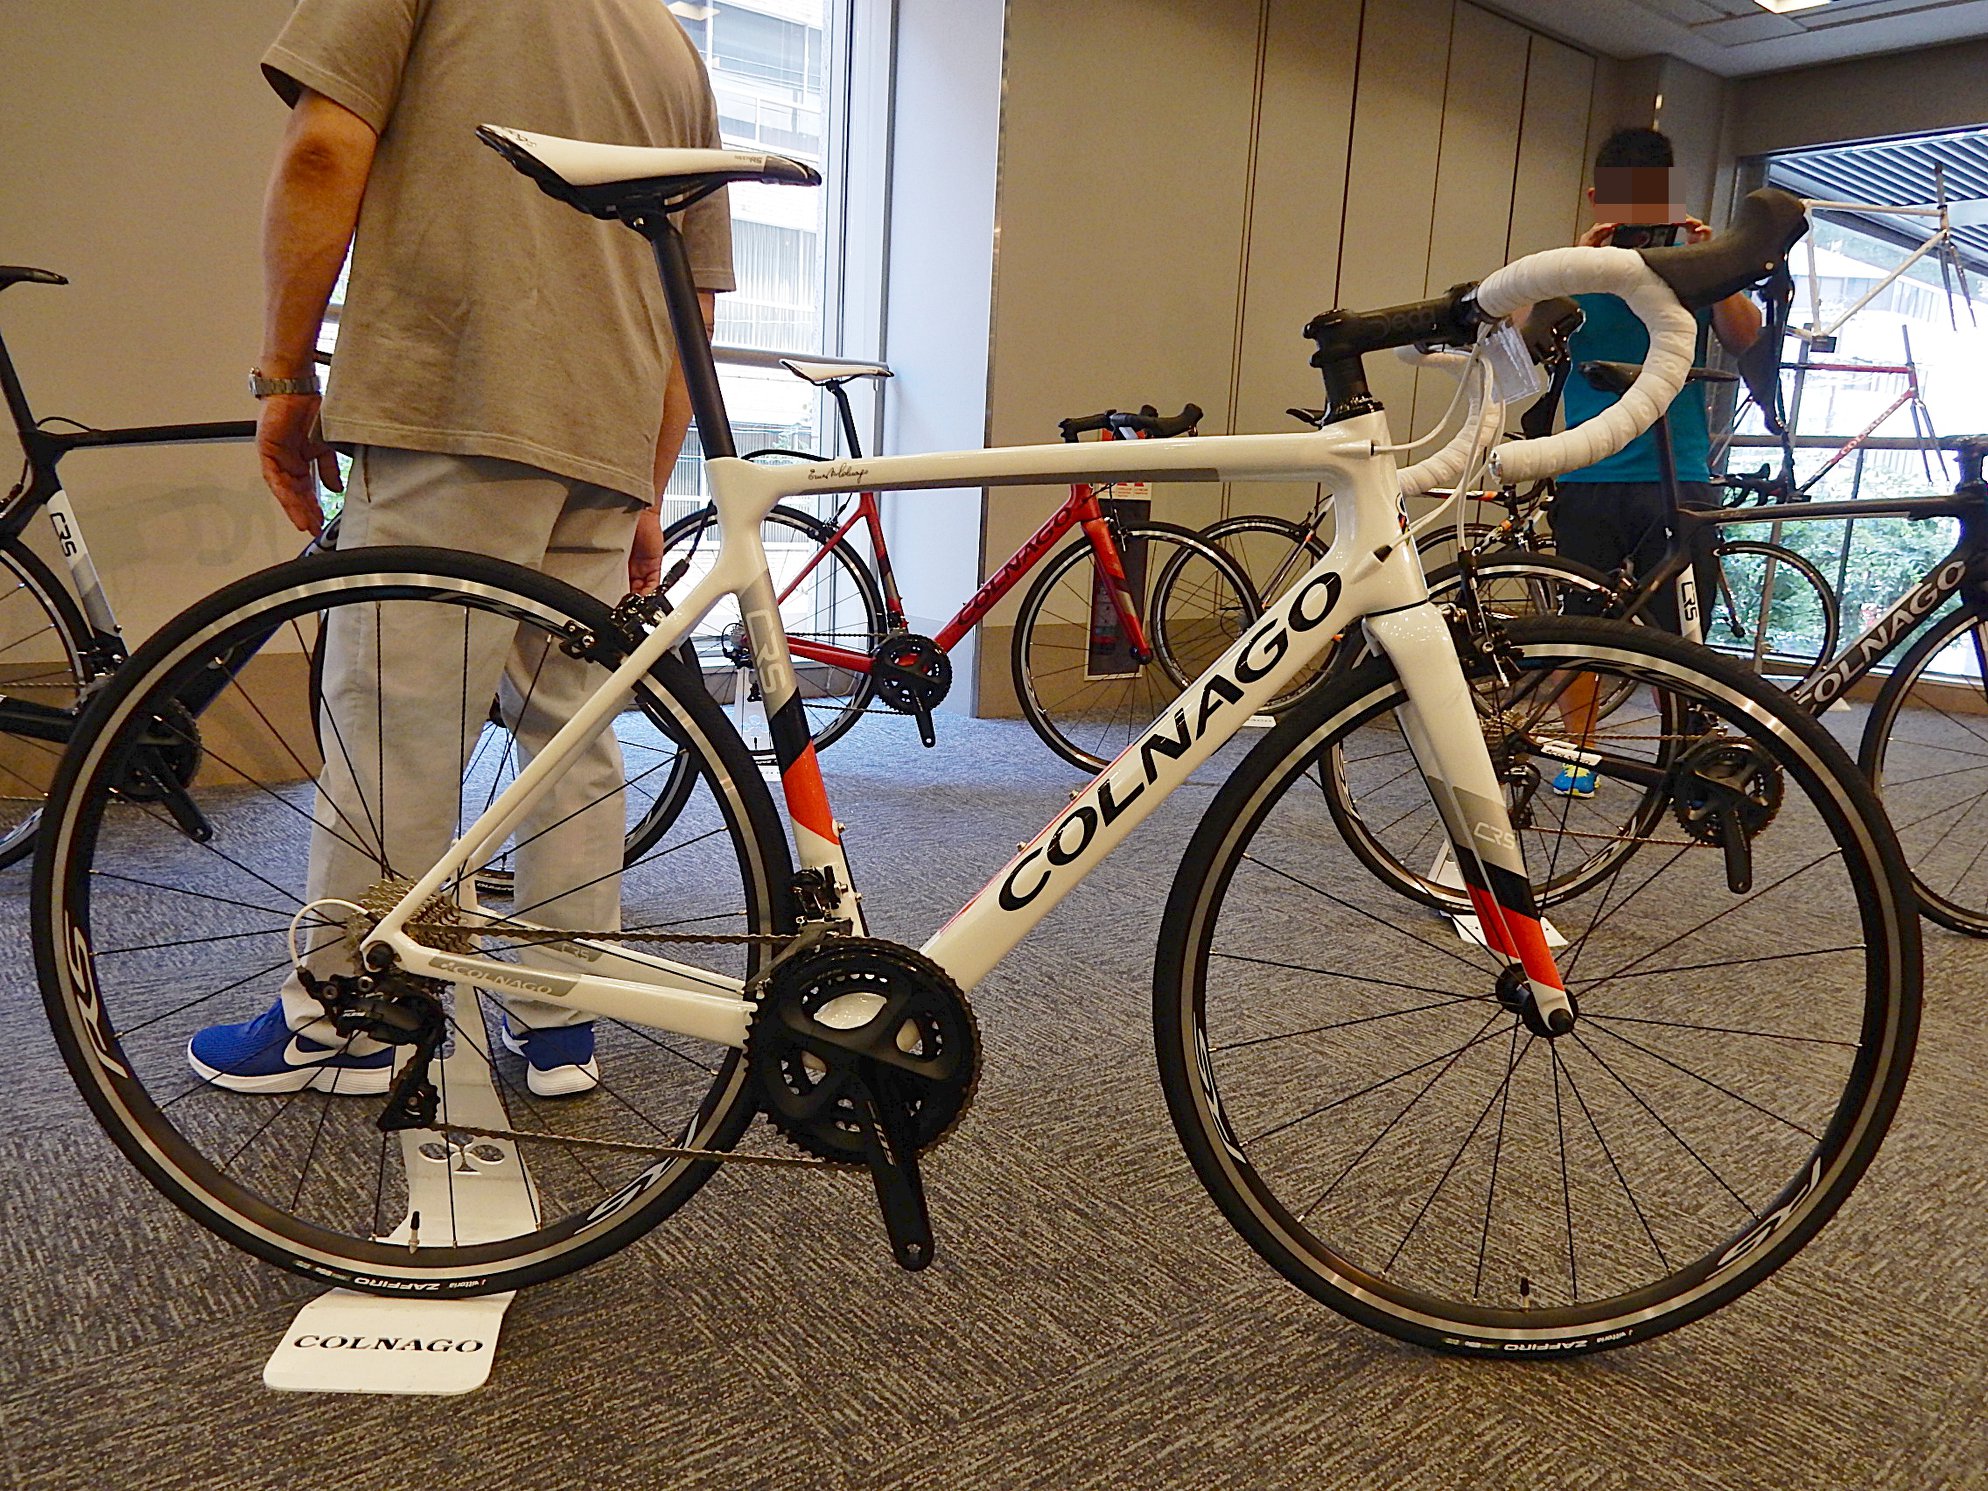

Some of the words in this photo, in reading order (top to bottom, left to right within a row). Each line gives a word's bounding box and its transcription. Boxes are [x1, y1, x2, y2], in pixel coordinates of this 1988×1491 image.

[50, 512, 77, 557] CRS
[958, 507, 1071, 625] COLNAGO
[1682, 581, 1697, 621] CRS
[745, 609, 786, 694] CRS
[998, 571, 1342, 912] COLNAGO
[1473, 821, 1516, 850] CRS
[453, 966, 553, 994] COLNAGO
[354, 1276, 441, 1291] ZAFFIRO
[294, 1334, 484, 1353] COLNAGO
[1503, 1339, 1589, 1351] ZAFFIRO
